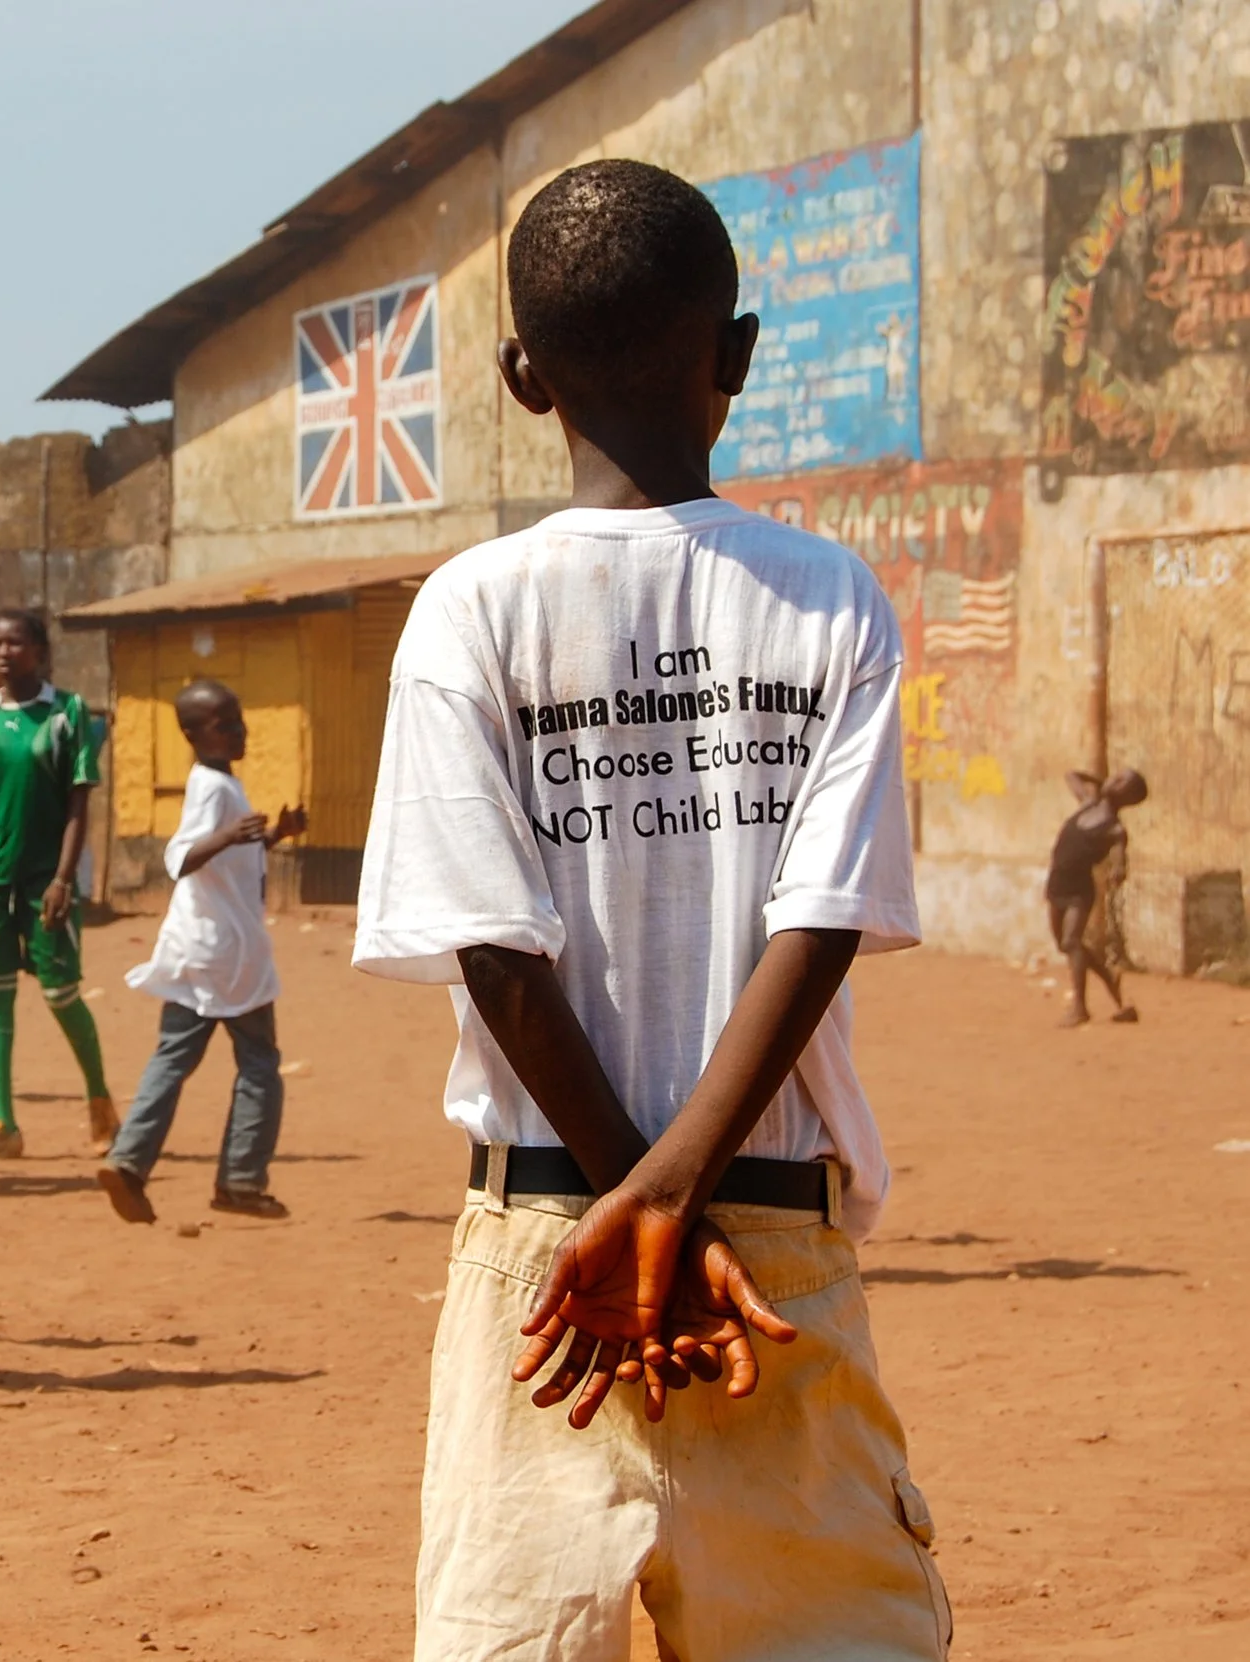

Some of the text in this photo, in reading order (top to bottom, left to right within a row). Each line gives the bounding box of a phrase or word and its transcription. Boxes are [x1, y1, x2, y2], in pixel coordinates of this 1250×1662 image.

[630, 640, 711, 680] I am
[615, 680, 731, 725] Salone's
[542, 744, 673, 786] Choose
[530, 786, 795, 848] NOT Child Lab
